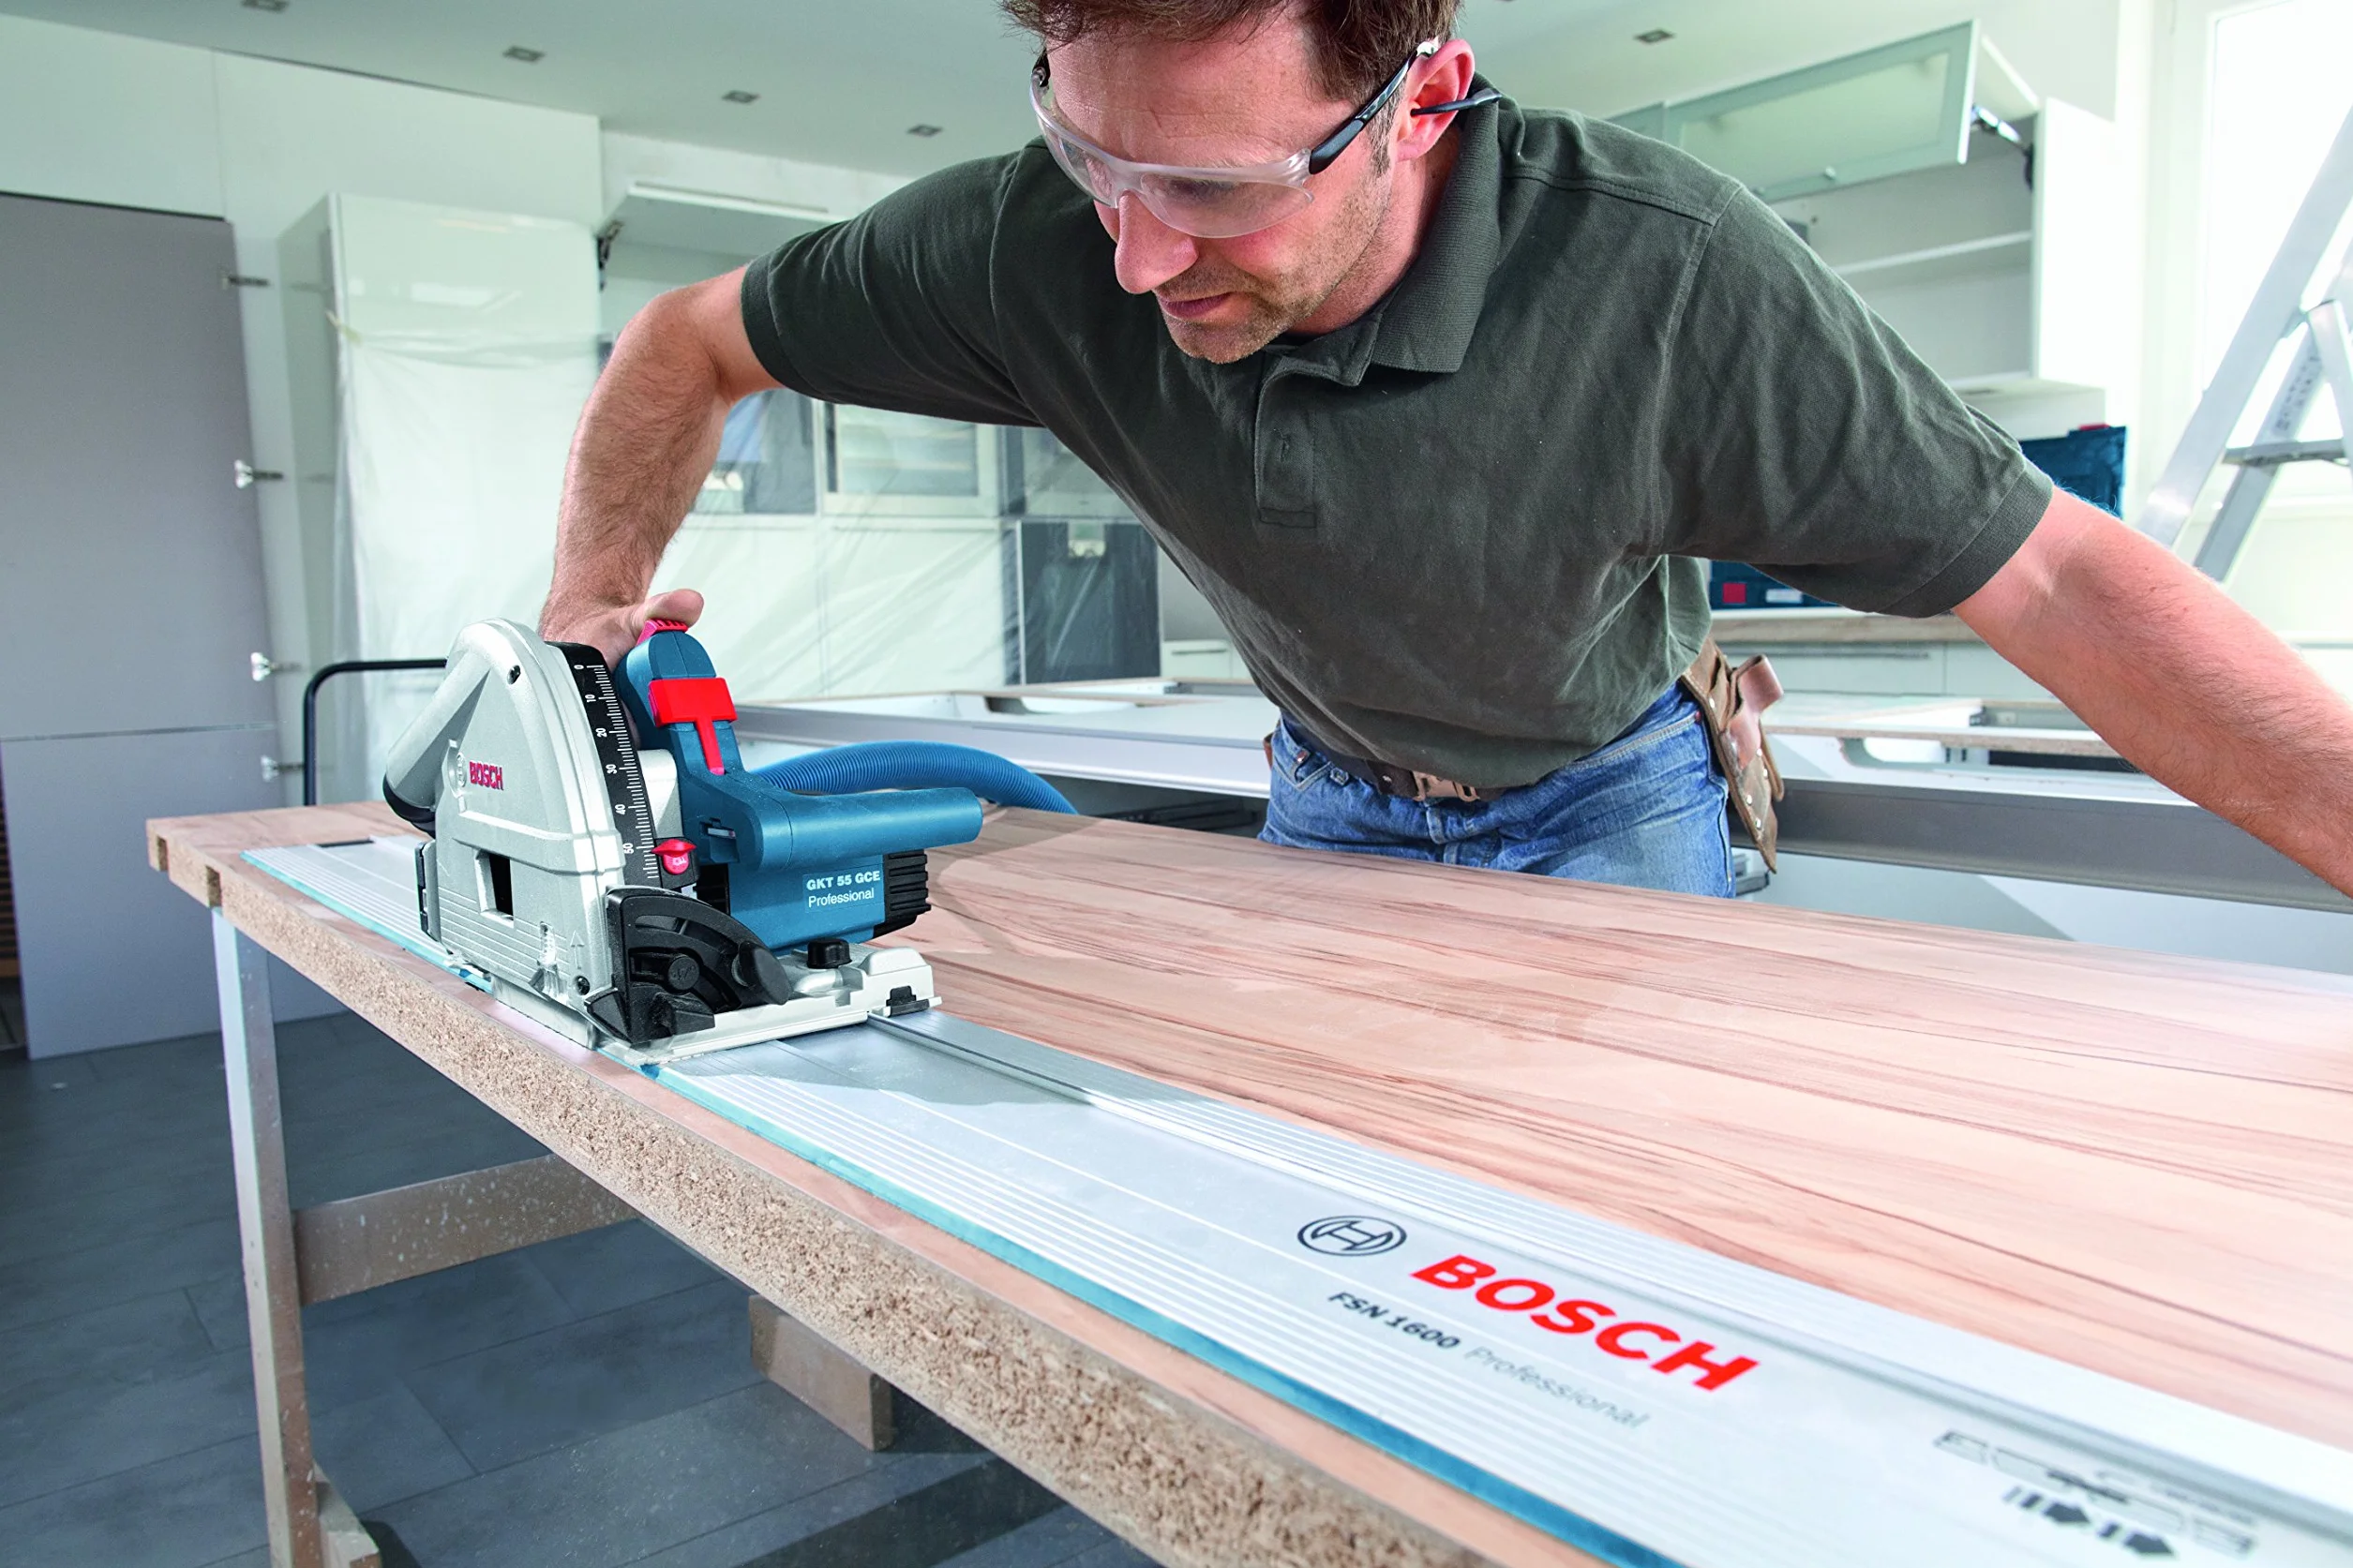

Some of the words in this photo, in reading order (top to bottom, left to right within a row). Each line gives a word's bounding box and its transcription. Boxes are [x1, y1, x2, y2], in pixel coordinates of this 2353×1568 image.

[585, 694, 597, 703] 10
[595, 727, 607, 738] 20
[469, 760, 504, 791] BOSCH
[606, 764, 618, 774] 30
[615, 804, 626, 815] 40
[622, 843, 635, 855] 50
[806, 877, 834, 890] GKT
[836, 874, 853, 887] 55
[854, 870, 881, 884] GCE
[808, 887, 875, 908] Professional
[1409, 1254, 1761, 1393] BOSCH
[1327, 1292, 1390, 1320] FSN
[1386, 1316, 1461, 1350] 1600
[1464, 1345, 1652, 1430] Professional
